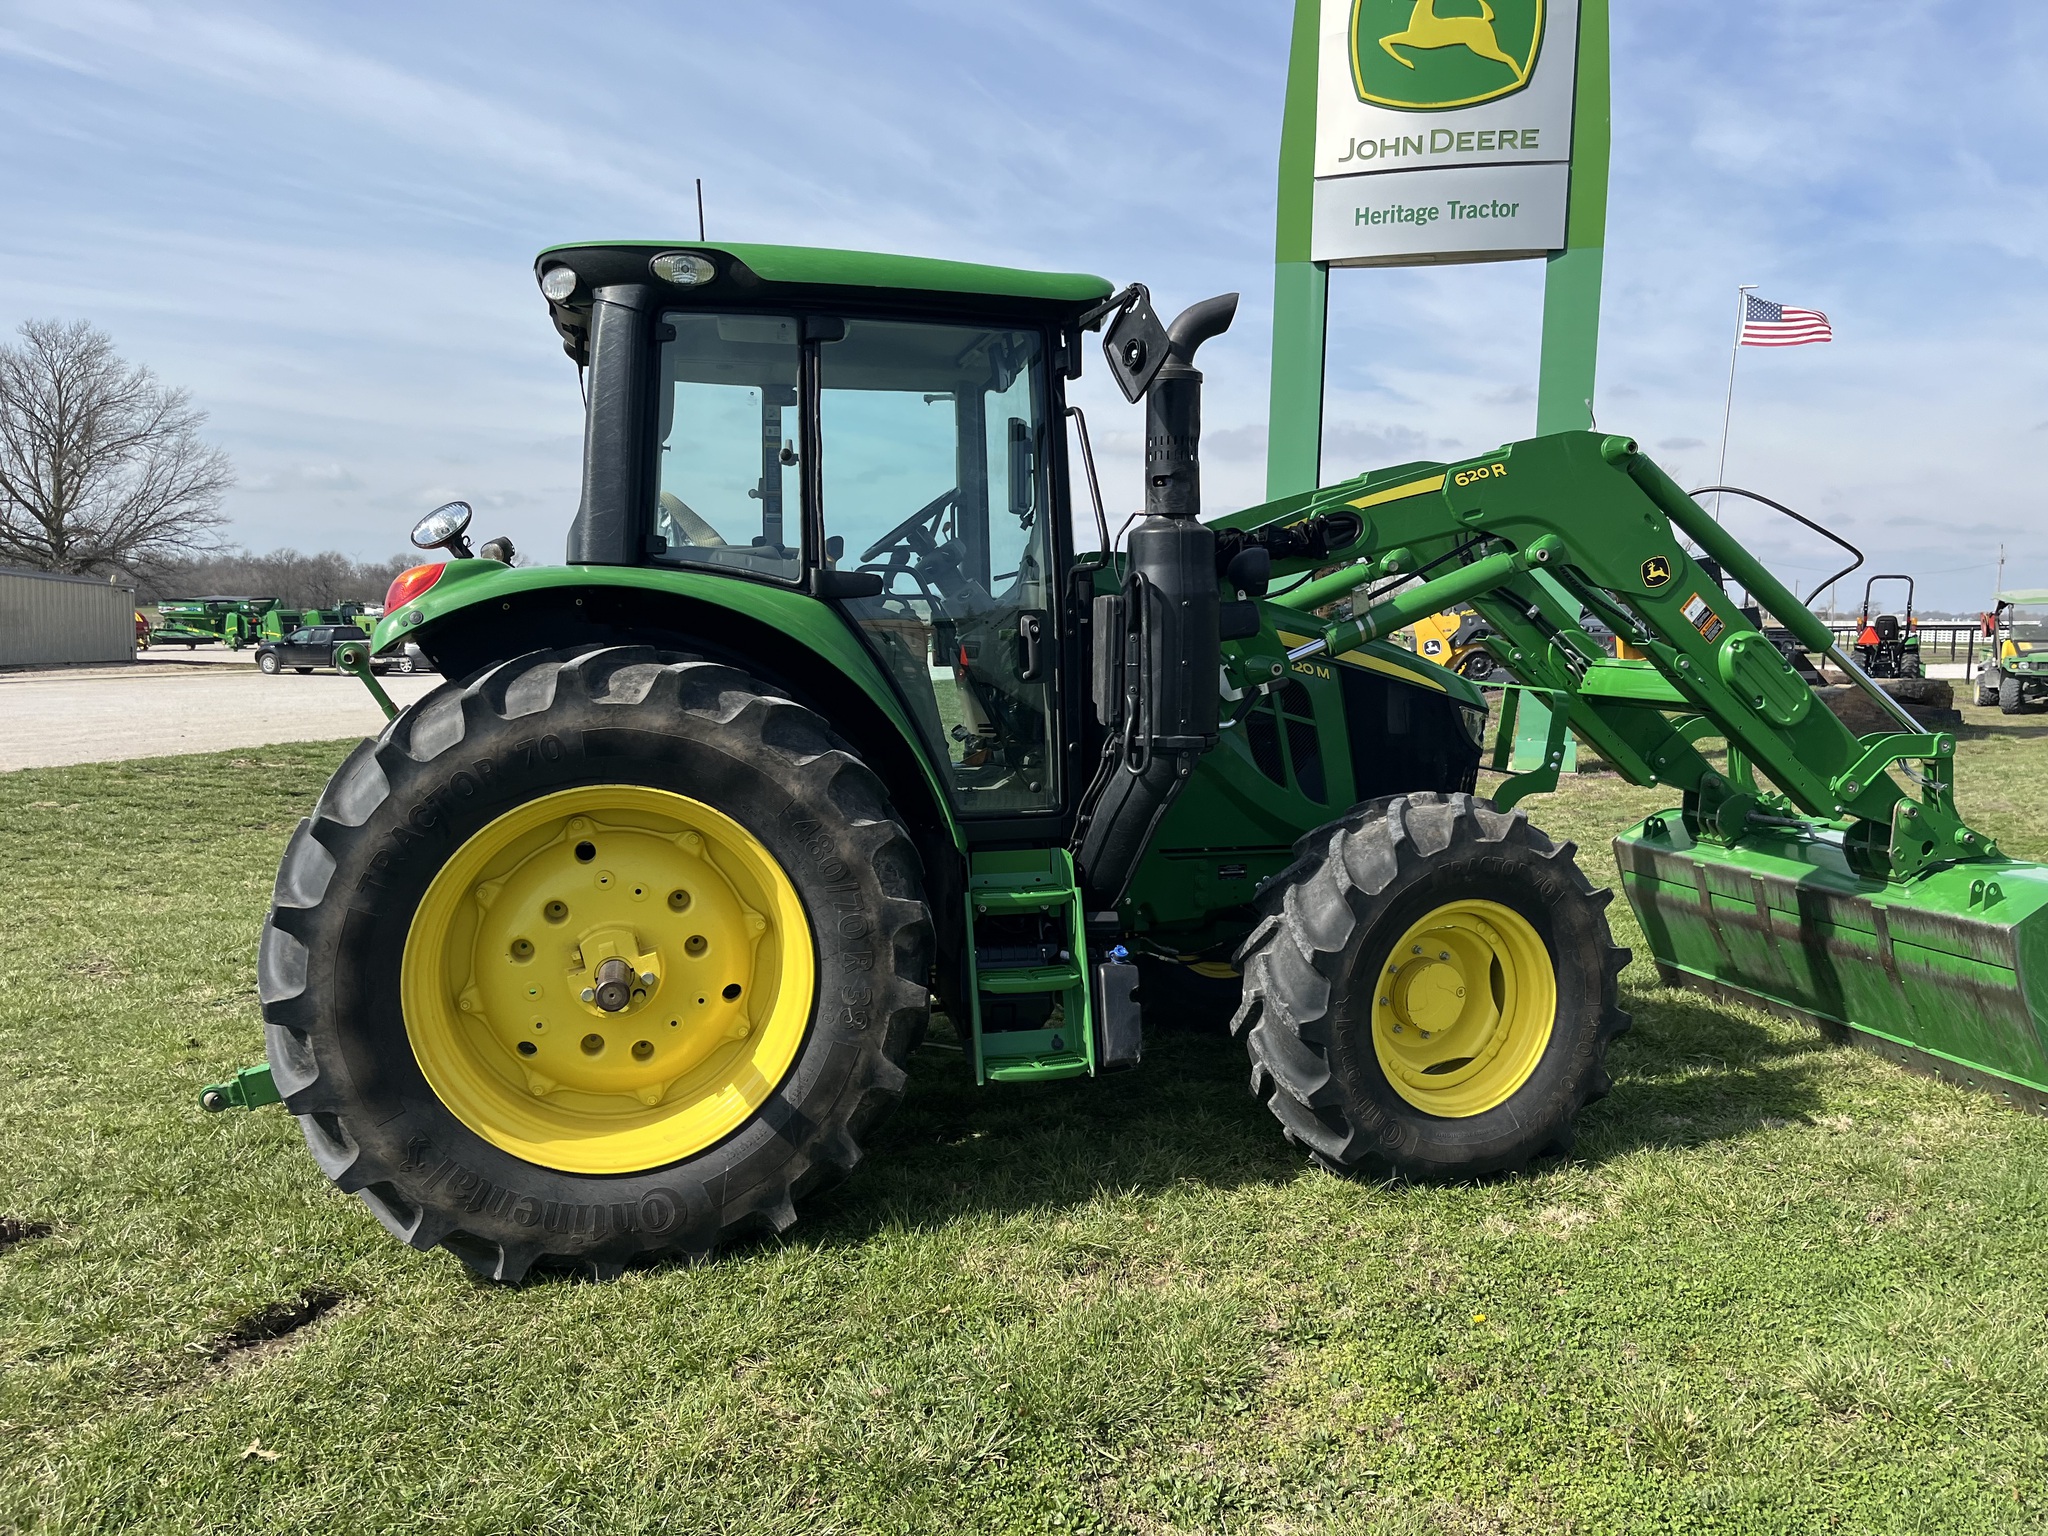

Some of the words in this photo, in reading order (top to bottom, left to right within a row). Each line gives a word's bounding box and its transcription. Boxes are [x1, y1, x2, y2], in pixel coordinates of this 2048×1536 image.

[1338, 134, 1424, 163] JOHN
[1429, 128, 1540, 154] DEERE
[1354, 204, 1440, 226] Heritage
[1447, 199, 1520, 220] Tractor
[1454, 467, 1490, 486] 620
[1490, 463, 1508, 478] R
[1316, 665, 1330, 680] M
[355, 757, 498, 894] TRACTOR
[514, 733, 567, 767] 70
[791, 818, 870, 941] 480/70
[1437, 855, 1531, 879] TRACTOR
[1532, 870, 1558, 898] 70
[842, 949, 874, 975] R
[838, 984, 873, 1031] 38
[419, 1155, 689, 1245] Continental
